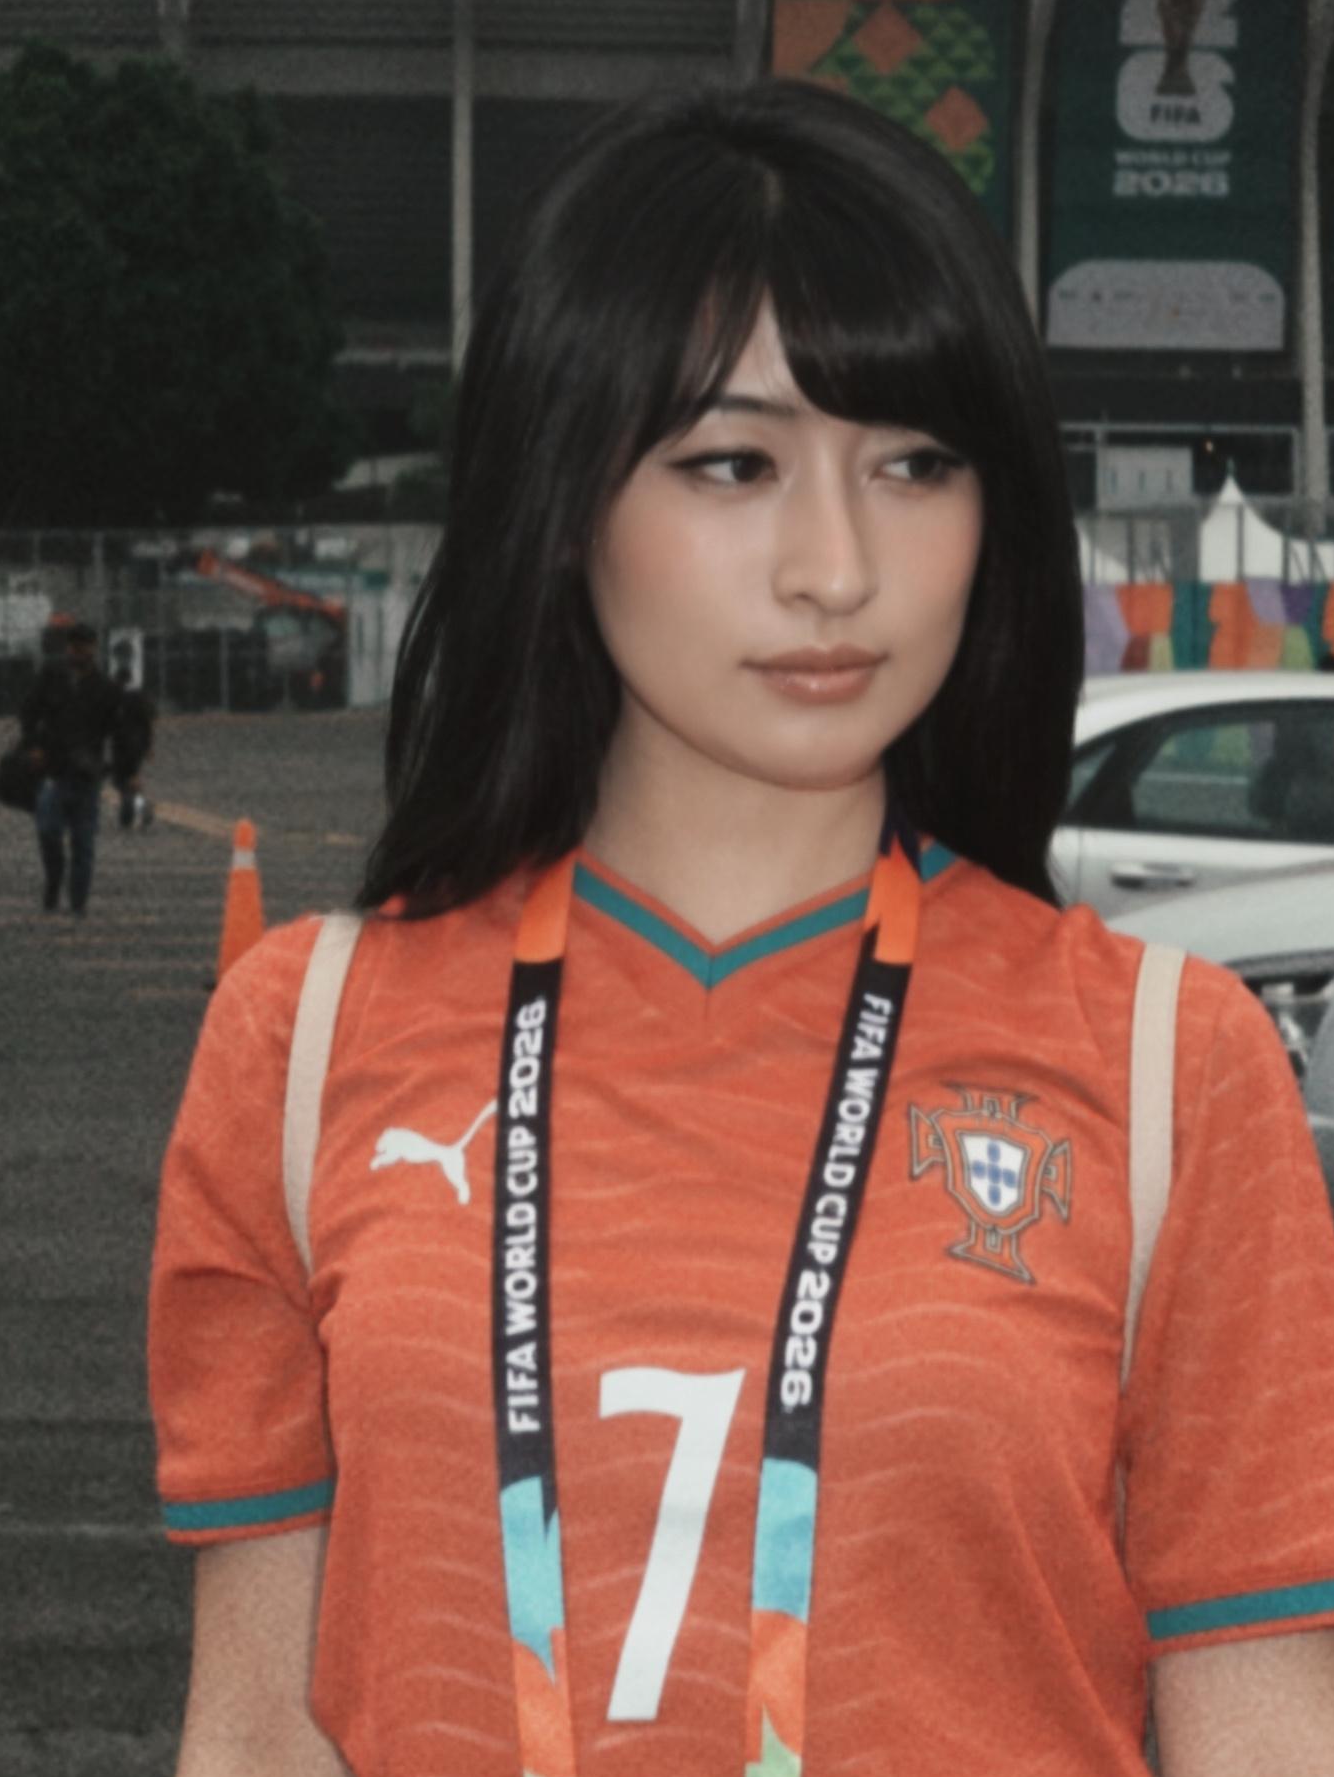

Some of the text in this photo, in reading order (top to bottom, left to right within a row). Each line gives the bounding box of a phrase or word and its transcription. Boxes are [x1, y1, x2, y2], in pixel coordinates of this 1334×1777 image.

[1113, 170, 1229, 197] 2026
[505, 996, 547, 1434] FIFA WORLD CUP 2026
[780, 992, 893, 1407] FIFA WORLD CUP 2026
[600, 1367, 746, 1721] 7
